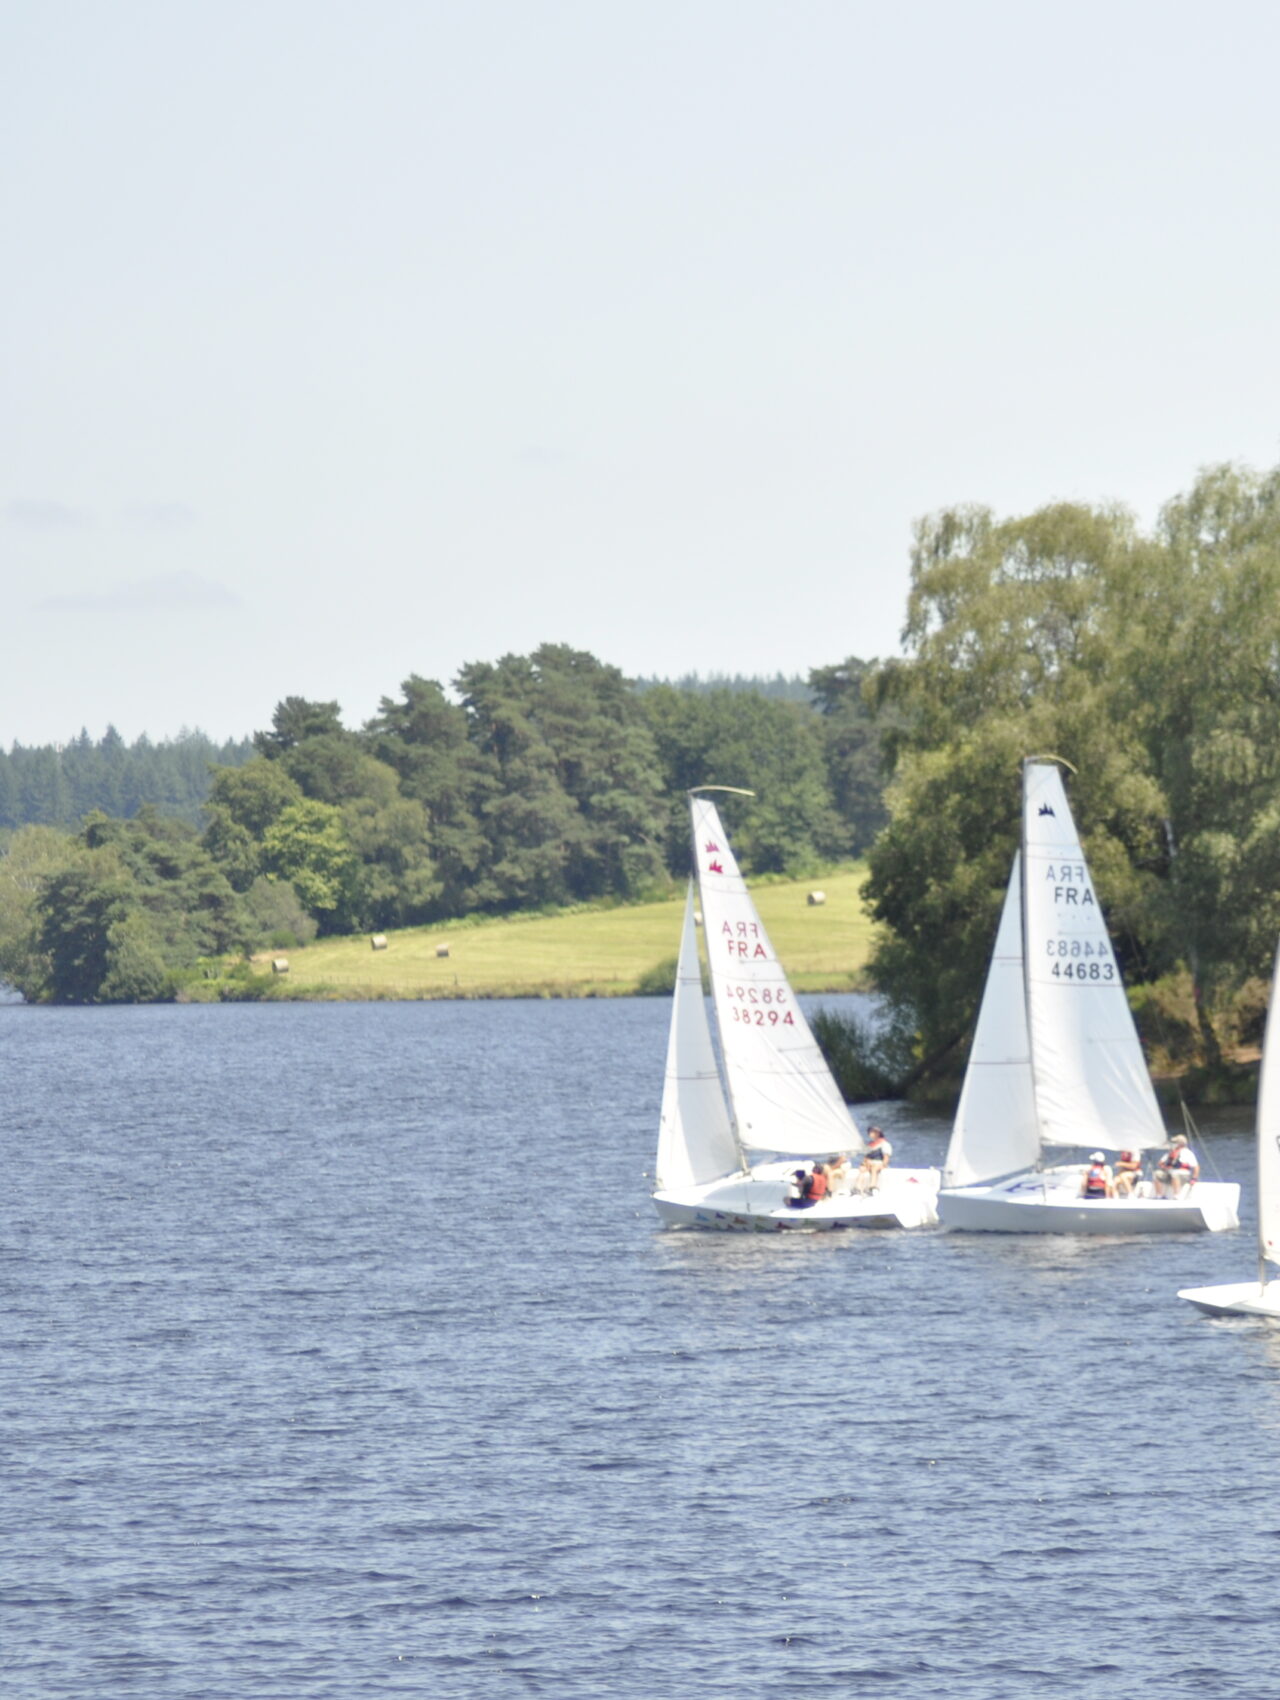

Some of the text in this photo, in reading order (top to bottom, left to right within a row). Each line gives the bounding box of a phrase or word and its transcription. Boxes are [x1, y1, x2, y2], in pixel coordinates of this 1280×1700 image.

[1054, 887, 1094, 905] FRA
[727, 940, 767, 959] FRA
[1051, 962, 1114, 980] 44683
[733, 1006, 794, 1026] 38294
